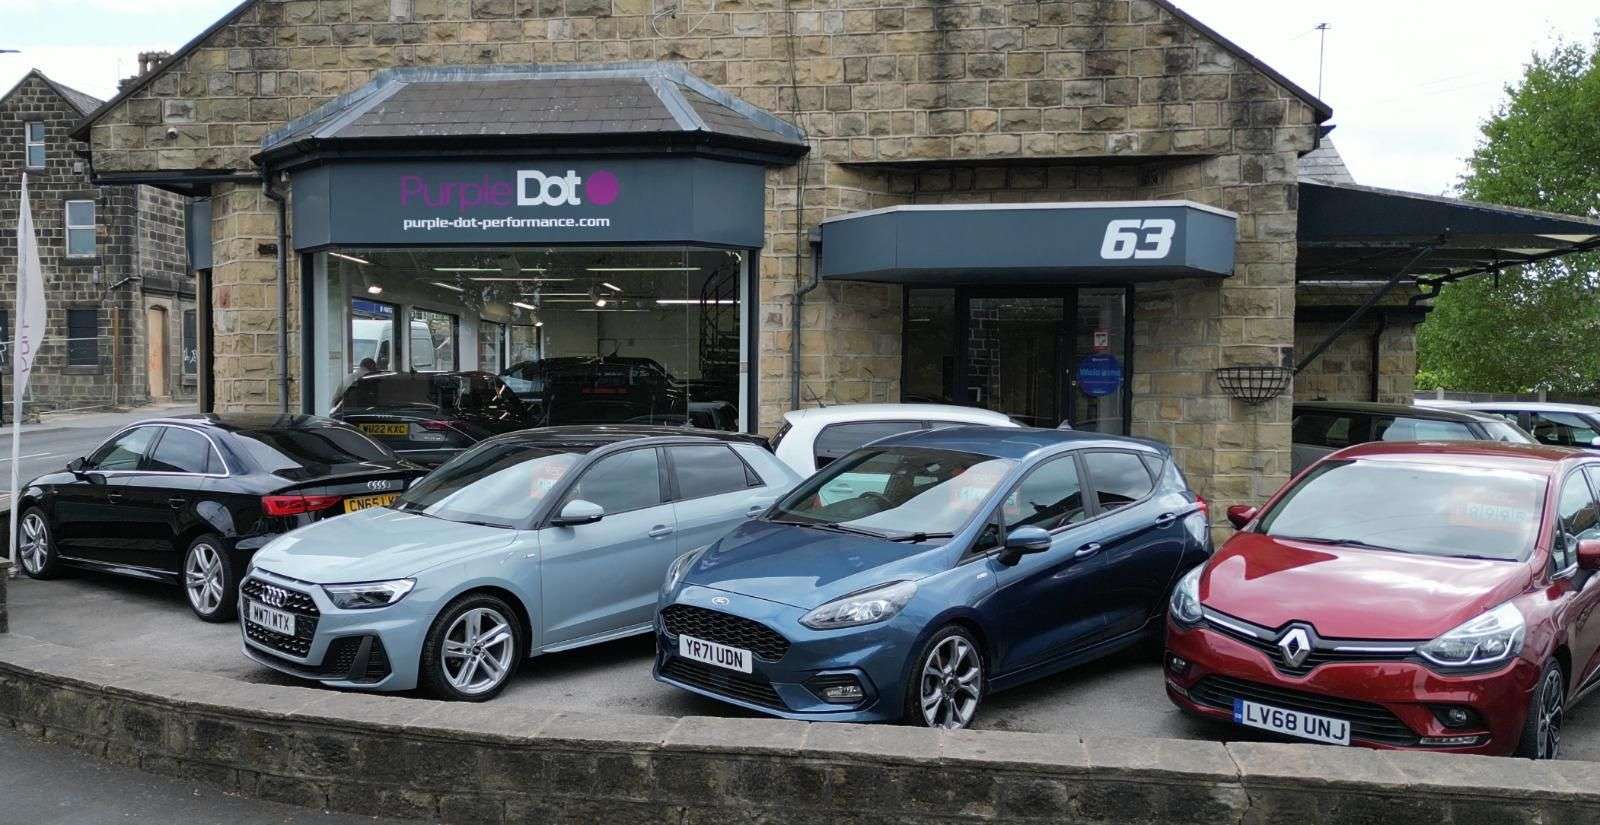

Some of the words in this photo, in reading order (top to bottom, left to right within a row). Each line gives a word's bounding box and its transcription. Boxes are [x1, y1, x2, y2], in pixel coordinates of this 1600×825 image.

[401, 174, 513, 214] Purple
[517, 170, 581, 206] Dot
[403, 217, 610, 230] purple-dot-performance.com
[1100, 219, 1176, 259] 63
[686, 639, 713, 661] YR71
[716, 648, 743, 668] UDN
[1246, 704, 1297, 731] LV68
[1303, 715, 1346, 740] UNJ
